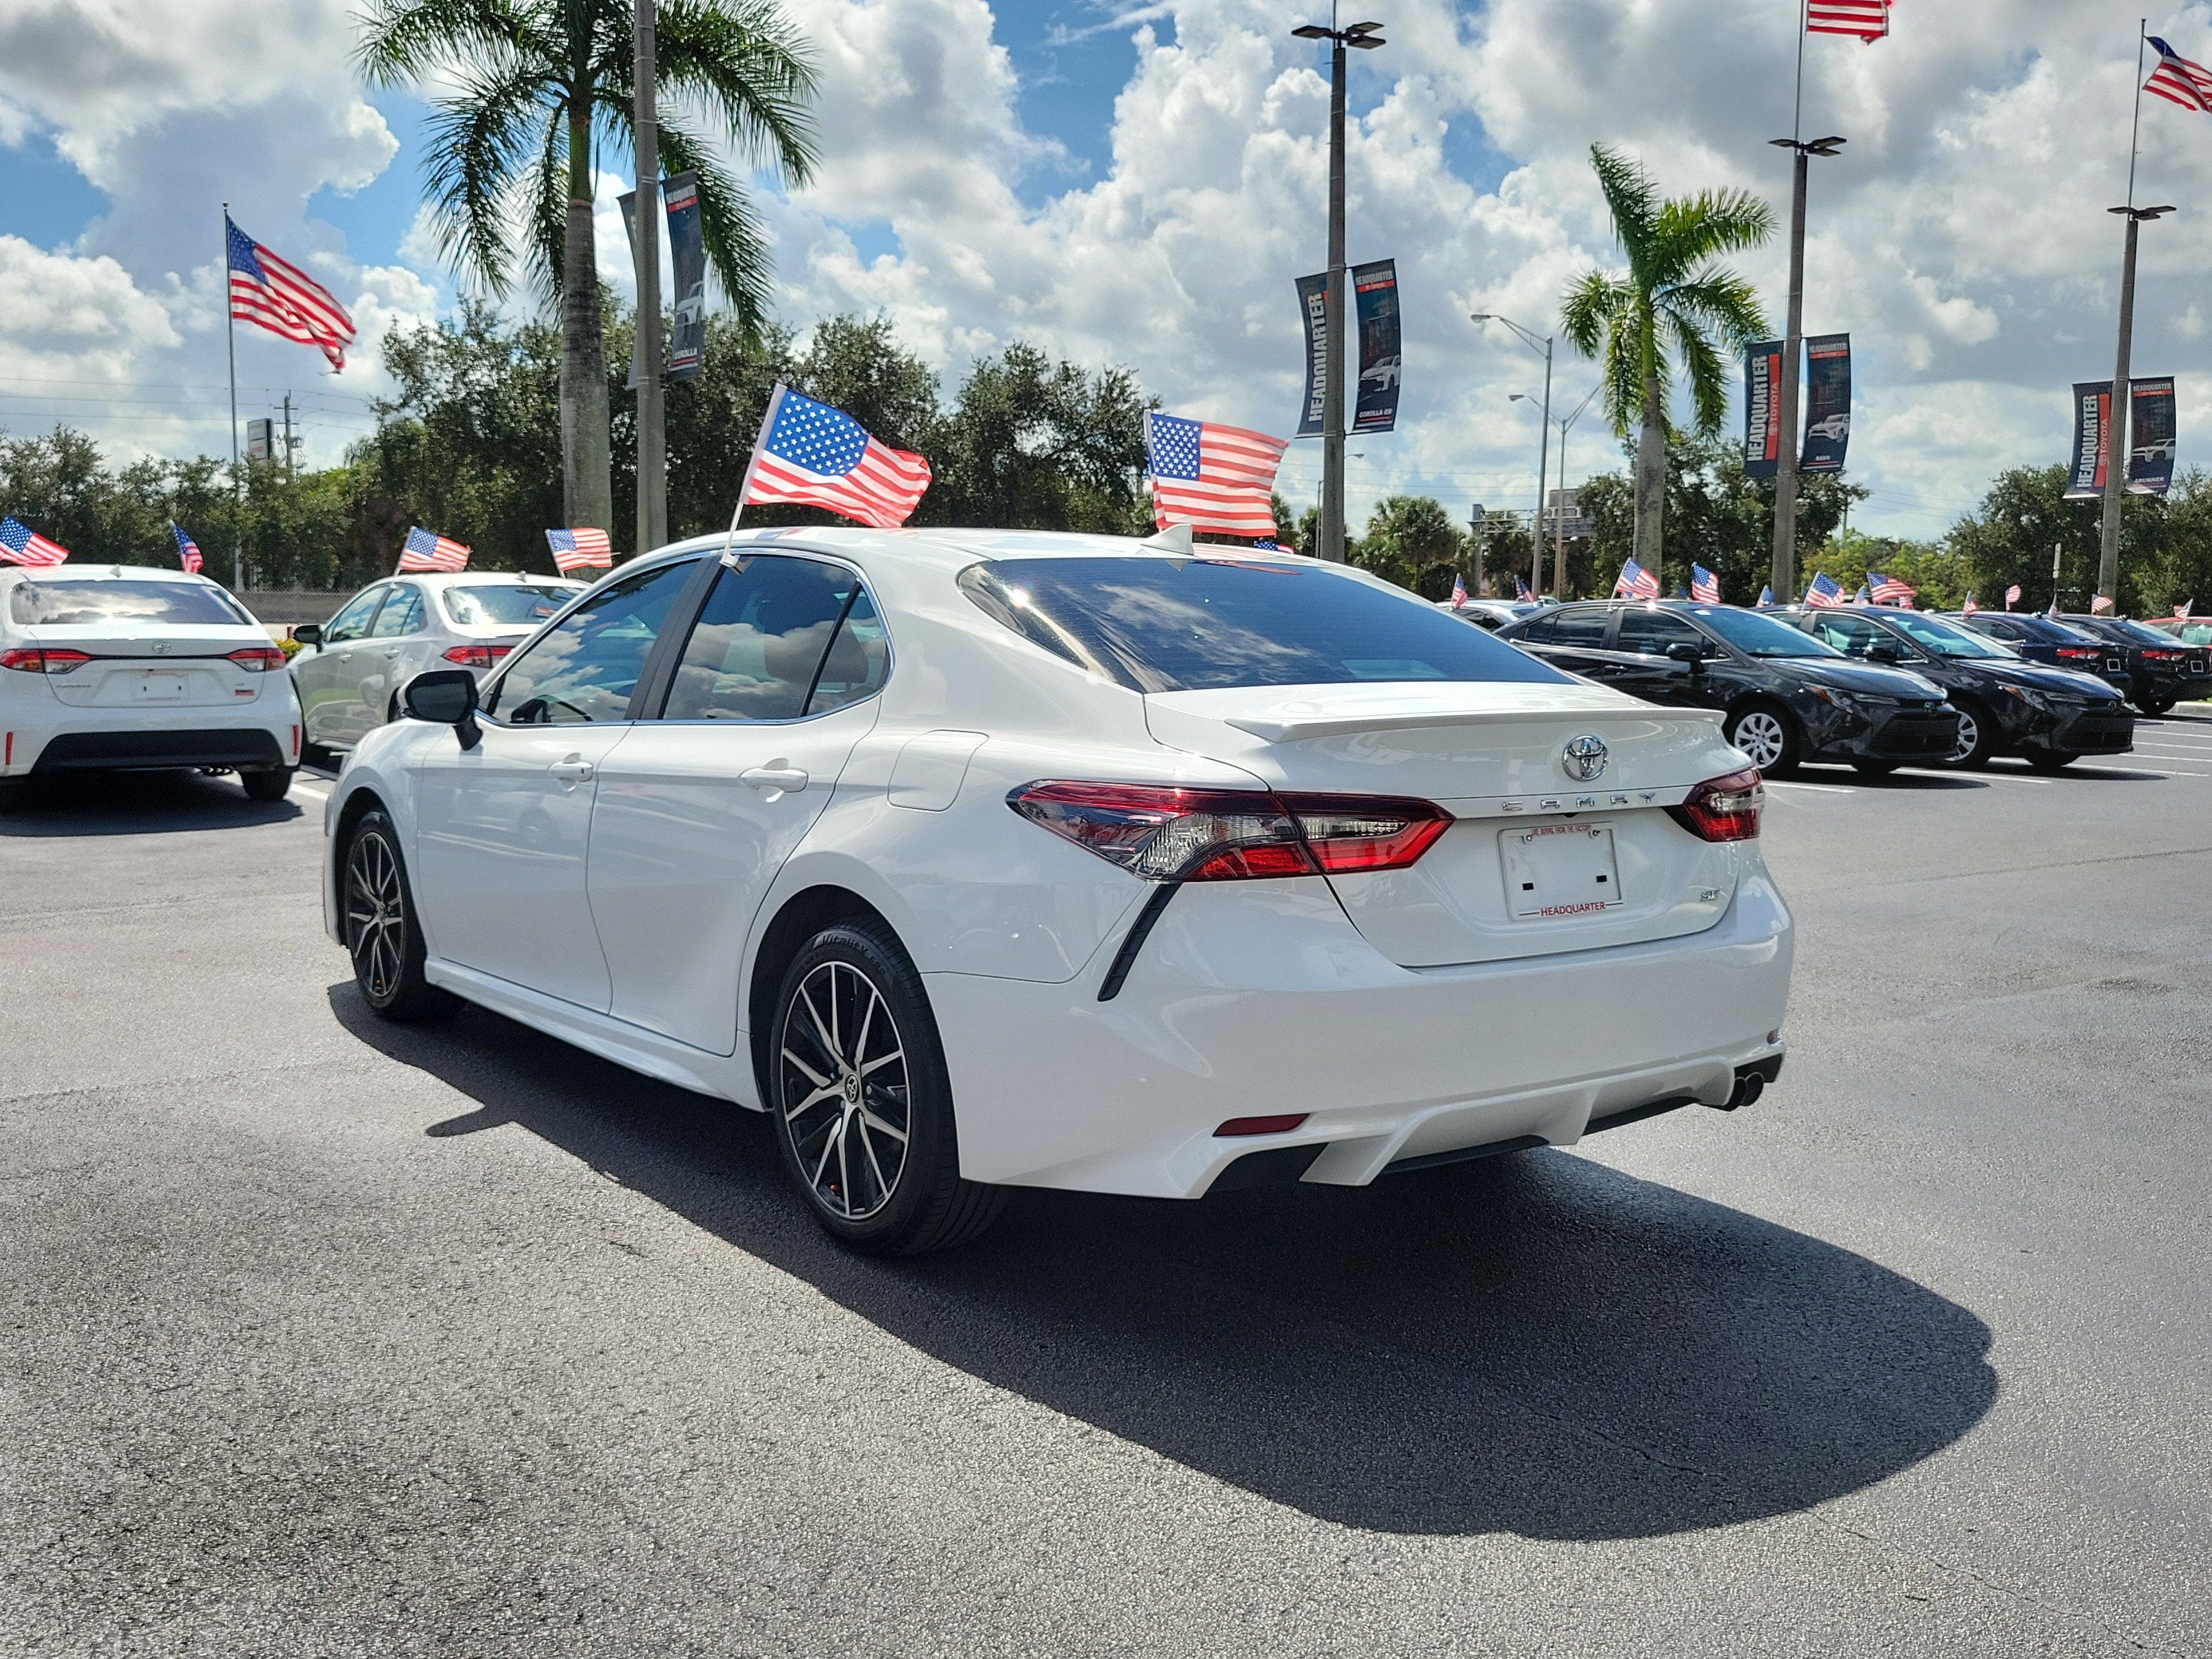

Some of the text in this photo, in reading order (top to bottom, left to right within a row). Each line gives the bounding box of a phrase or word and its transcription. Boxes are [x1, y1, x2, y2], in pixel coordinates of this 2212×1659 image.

[1746, 355, 1769, 461] HEADQUARTER
[1770, 382, 1779, 422] TOYOTA
[2076, 394, 2098, 488] HEADQUARTER
[2100, 419, 2108, 454] TOYOTA
[1502, 793, 1655, 811] CAMRY
[1541, 901, 1605, 916] HEADQUARTER
